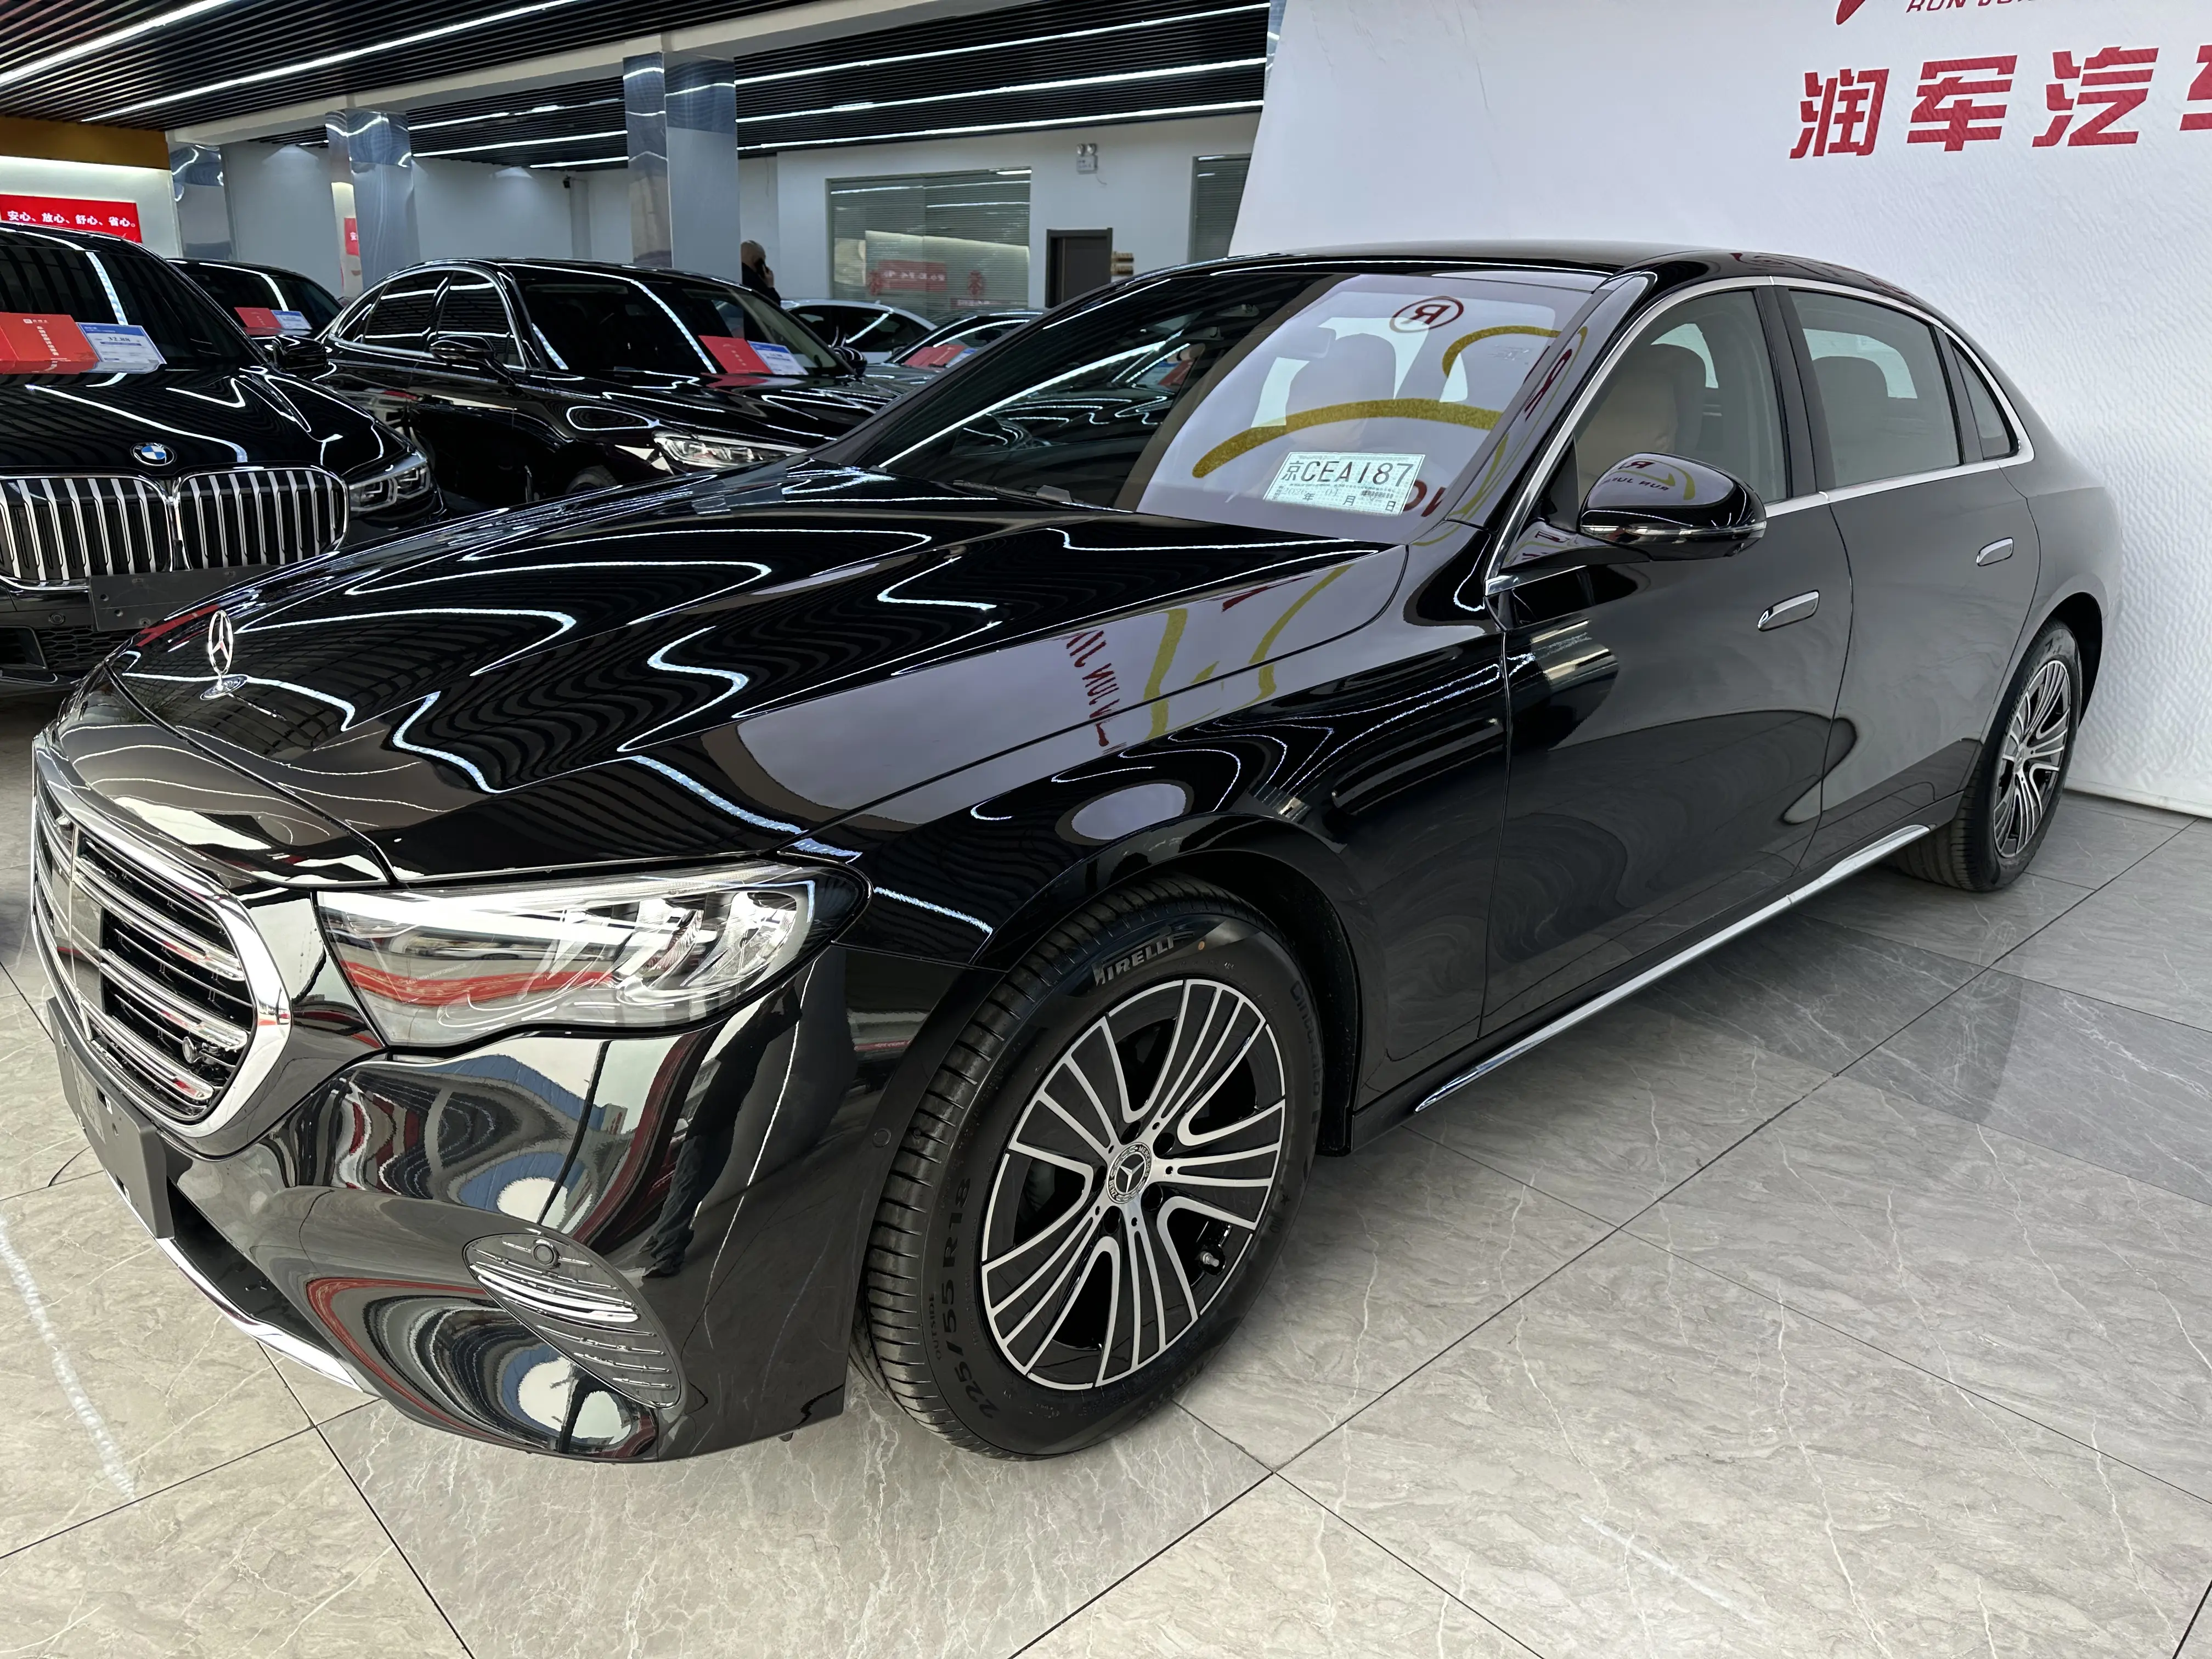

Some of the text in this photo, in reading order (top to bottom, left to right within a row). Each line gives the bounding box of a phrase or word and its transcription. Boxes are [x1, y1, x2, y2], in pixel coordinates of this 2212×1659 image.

[1282, 460, 1414, 487] 京CEA187
[1091, 925, 1194, 986] PIRELLI
[1109, 1179, 1118, 1198] BENZ
[928, 1292, 943, 1361] OUTSIDE
[941, 1279, 1000, 1419] 225/55
